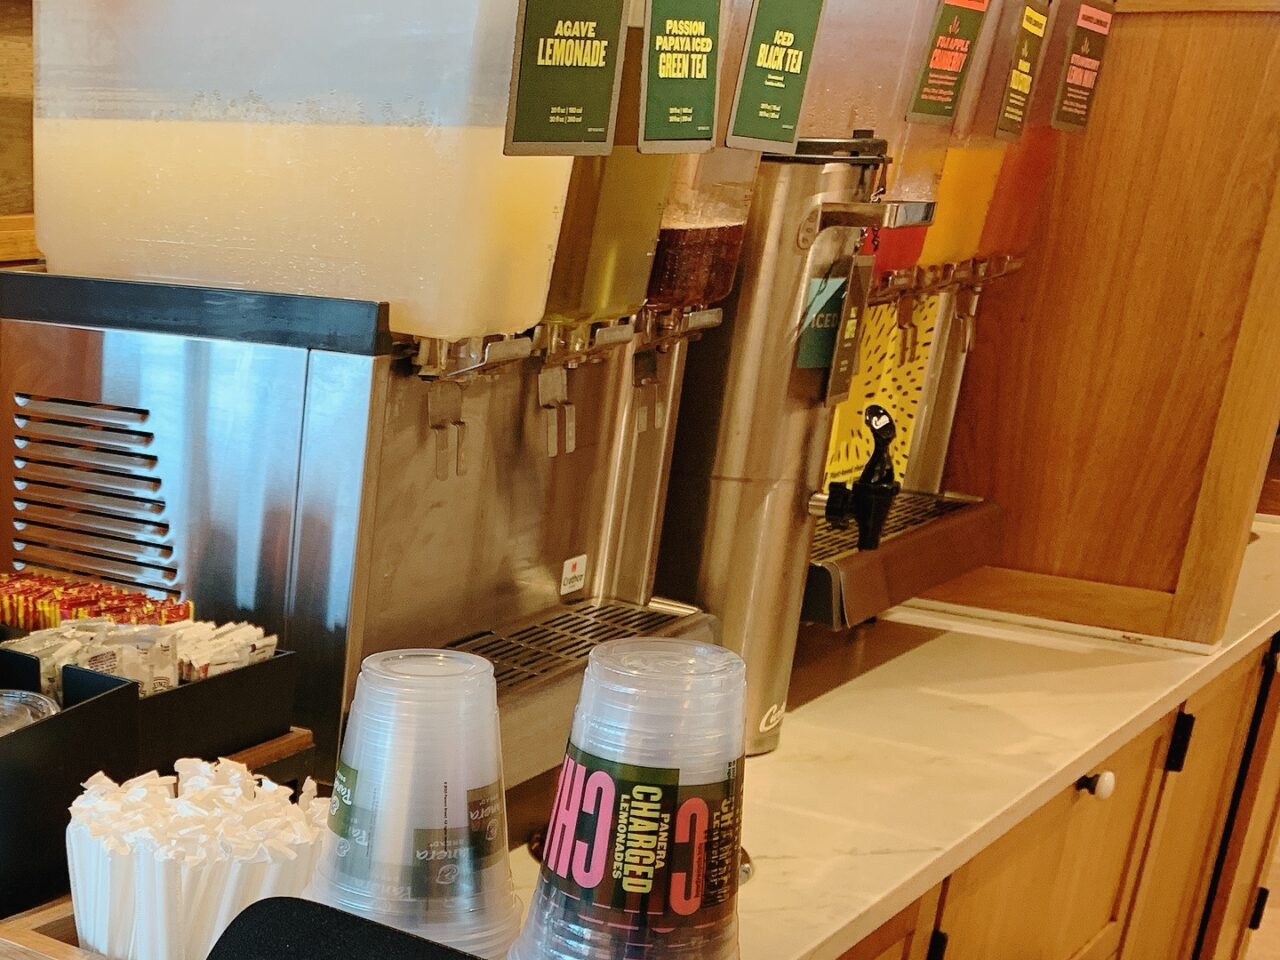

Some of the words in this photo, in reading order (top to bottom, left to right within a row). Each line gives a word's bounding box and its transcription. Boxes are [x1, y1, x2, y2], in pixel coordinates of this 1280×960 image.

[554, 20, 597, 38] AGAVE
[665, 19, 706, 36] PASSION
[773, 30, 795, 47] ICED
[536, 37, 608, 68] LEMONADE
[655, 35, 691, 52] PAPAYA
[690, 37, 713, 53] ICED
[756, 43, 784, 72] BLACK
[782, 48, 803, 74] TEA
[658, 52, 689, 79] GREEN
[688, 53, 708, 79] TEA
[612, 794, 631, 880] LEMONADES
[622, 785, 663, 894] CHARGED
[655, 813, 671, 870] PANERA
